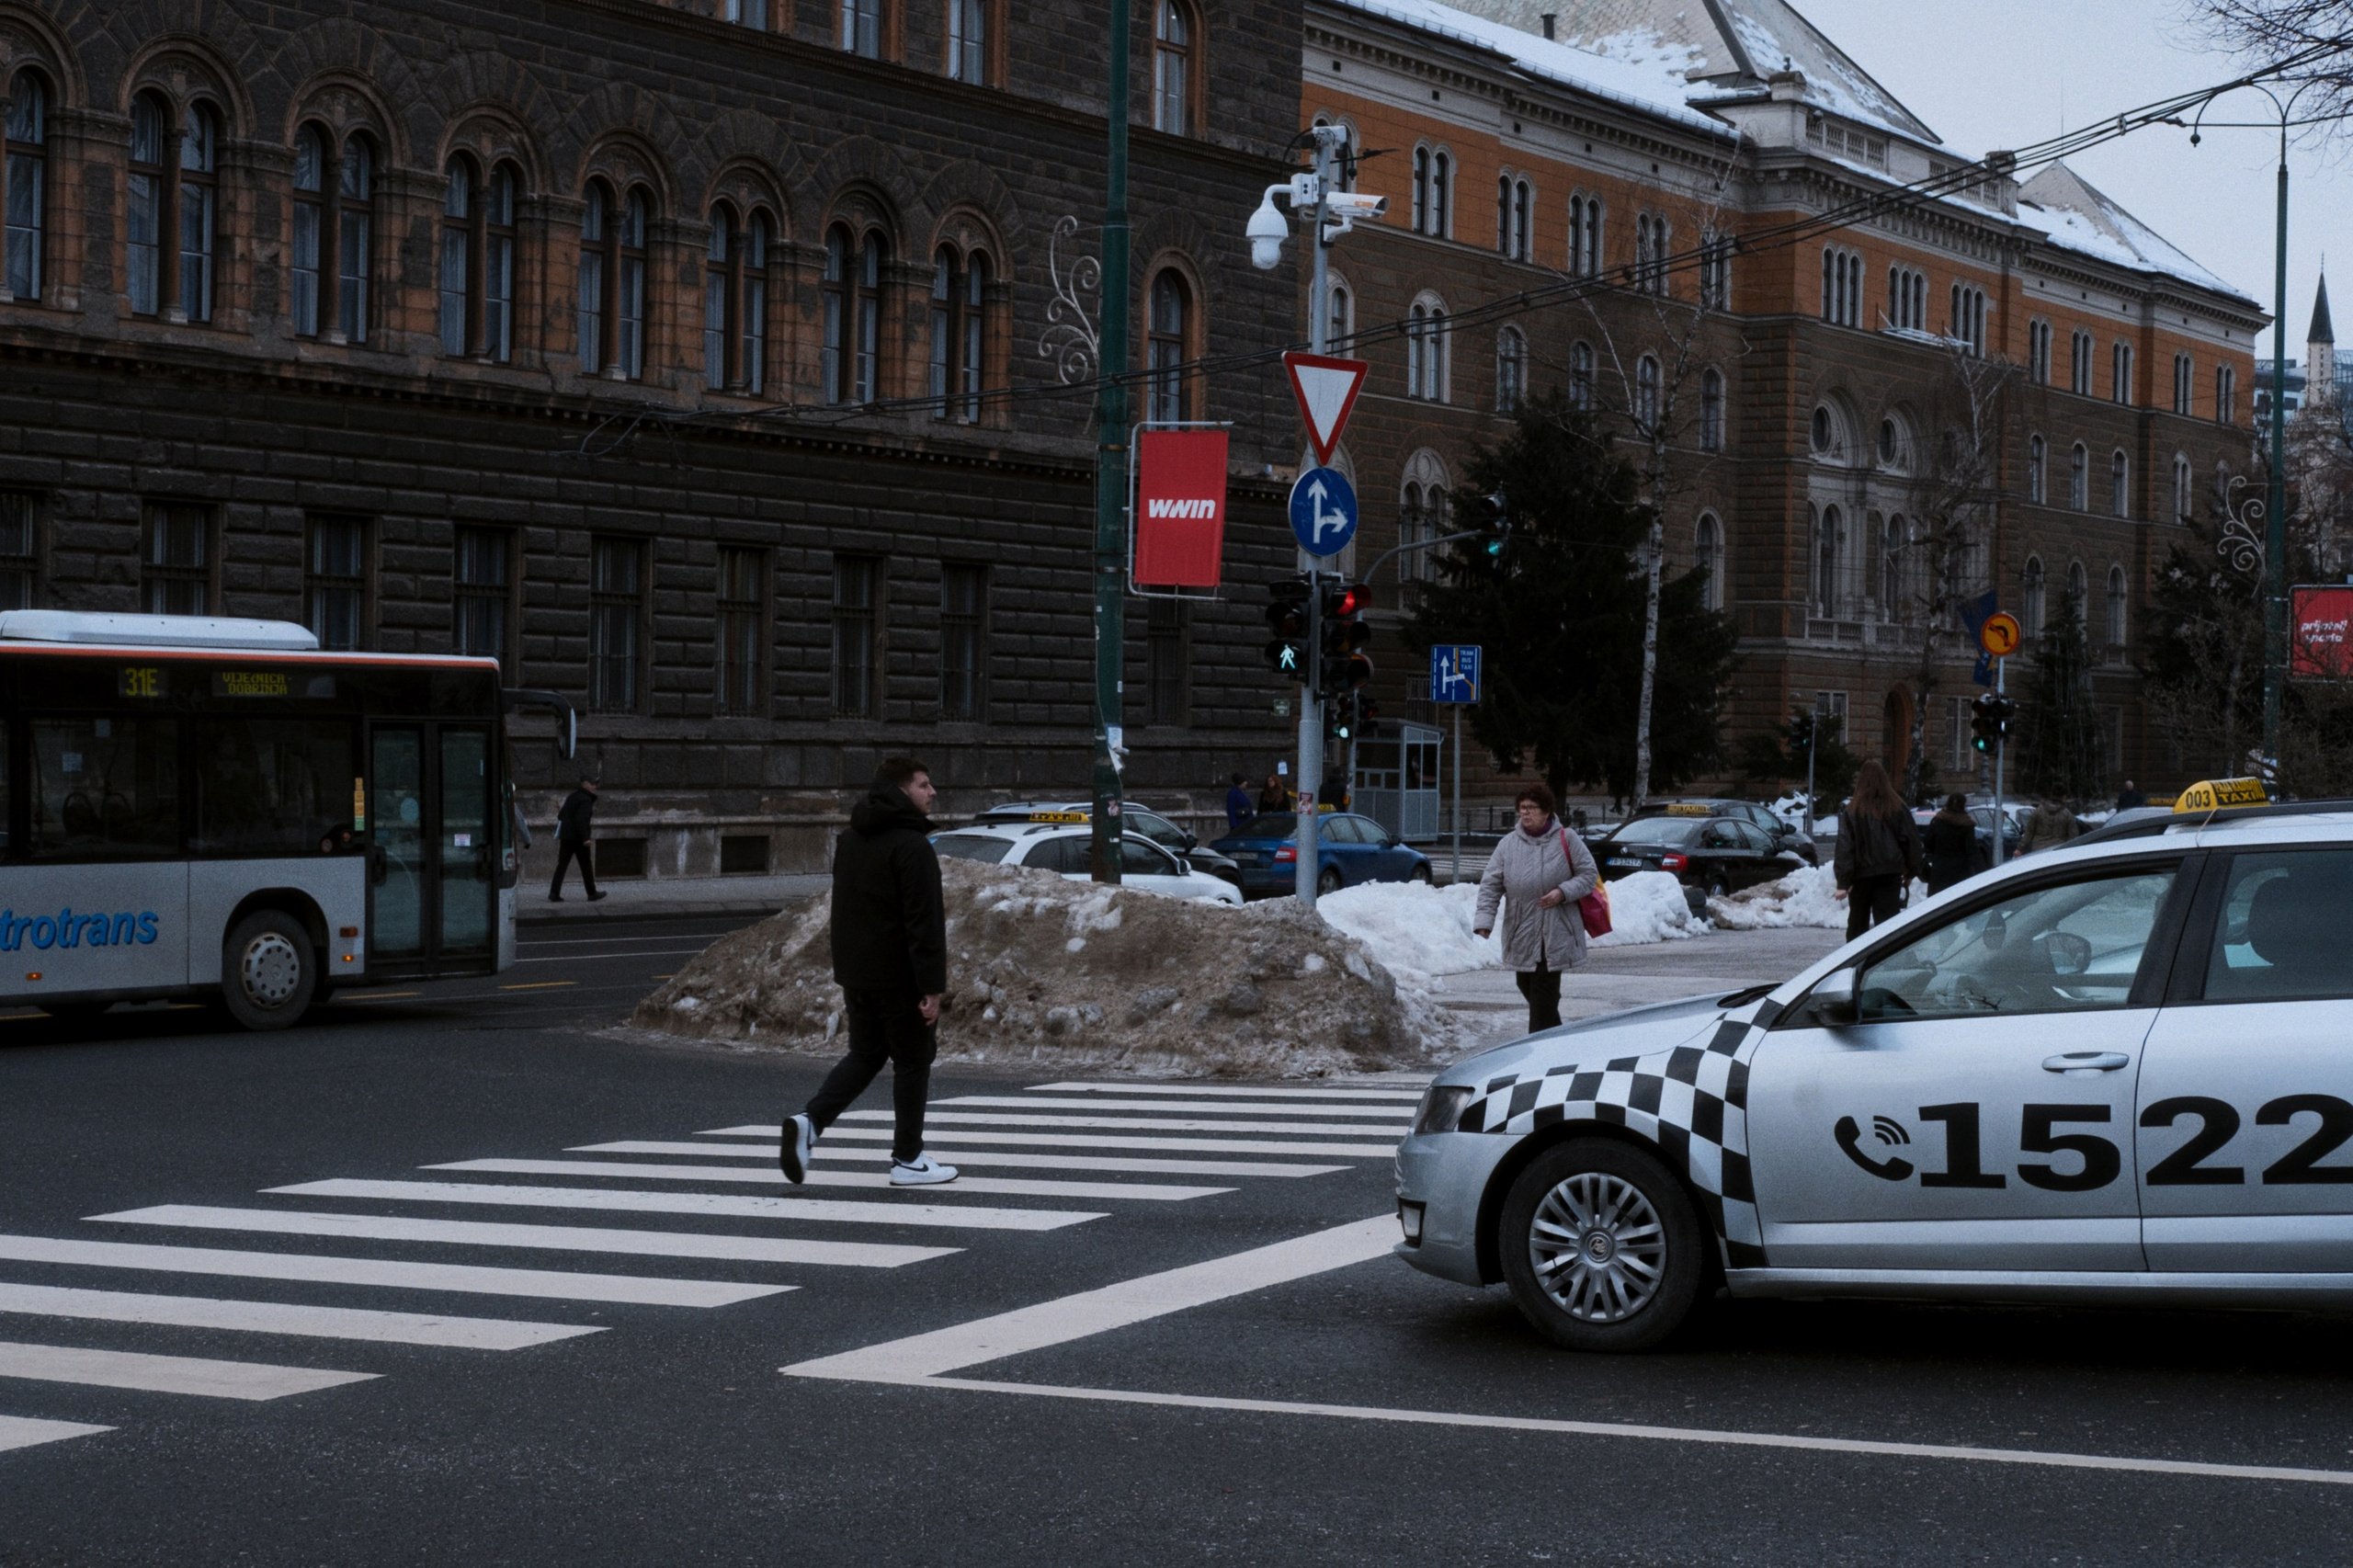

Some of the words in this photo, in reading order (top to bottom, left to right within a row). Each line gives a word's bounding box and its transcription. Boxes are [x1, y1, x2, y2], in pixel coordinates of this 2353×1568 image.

[1148, 498, 1216, 519] wwin
[124, 667, 159, 697] 31E
[228, 683, 288, 695] DOBRINJA
[2186, 790, 2211, 809] 003
[2218, 791, 2256, 802] TAXI
[0, 906, 159, 951] trotrans
[1918, 1094, 2353, 1192] 1522
